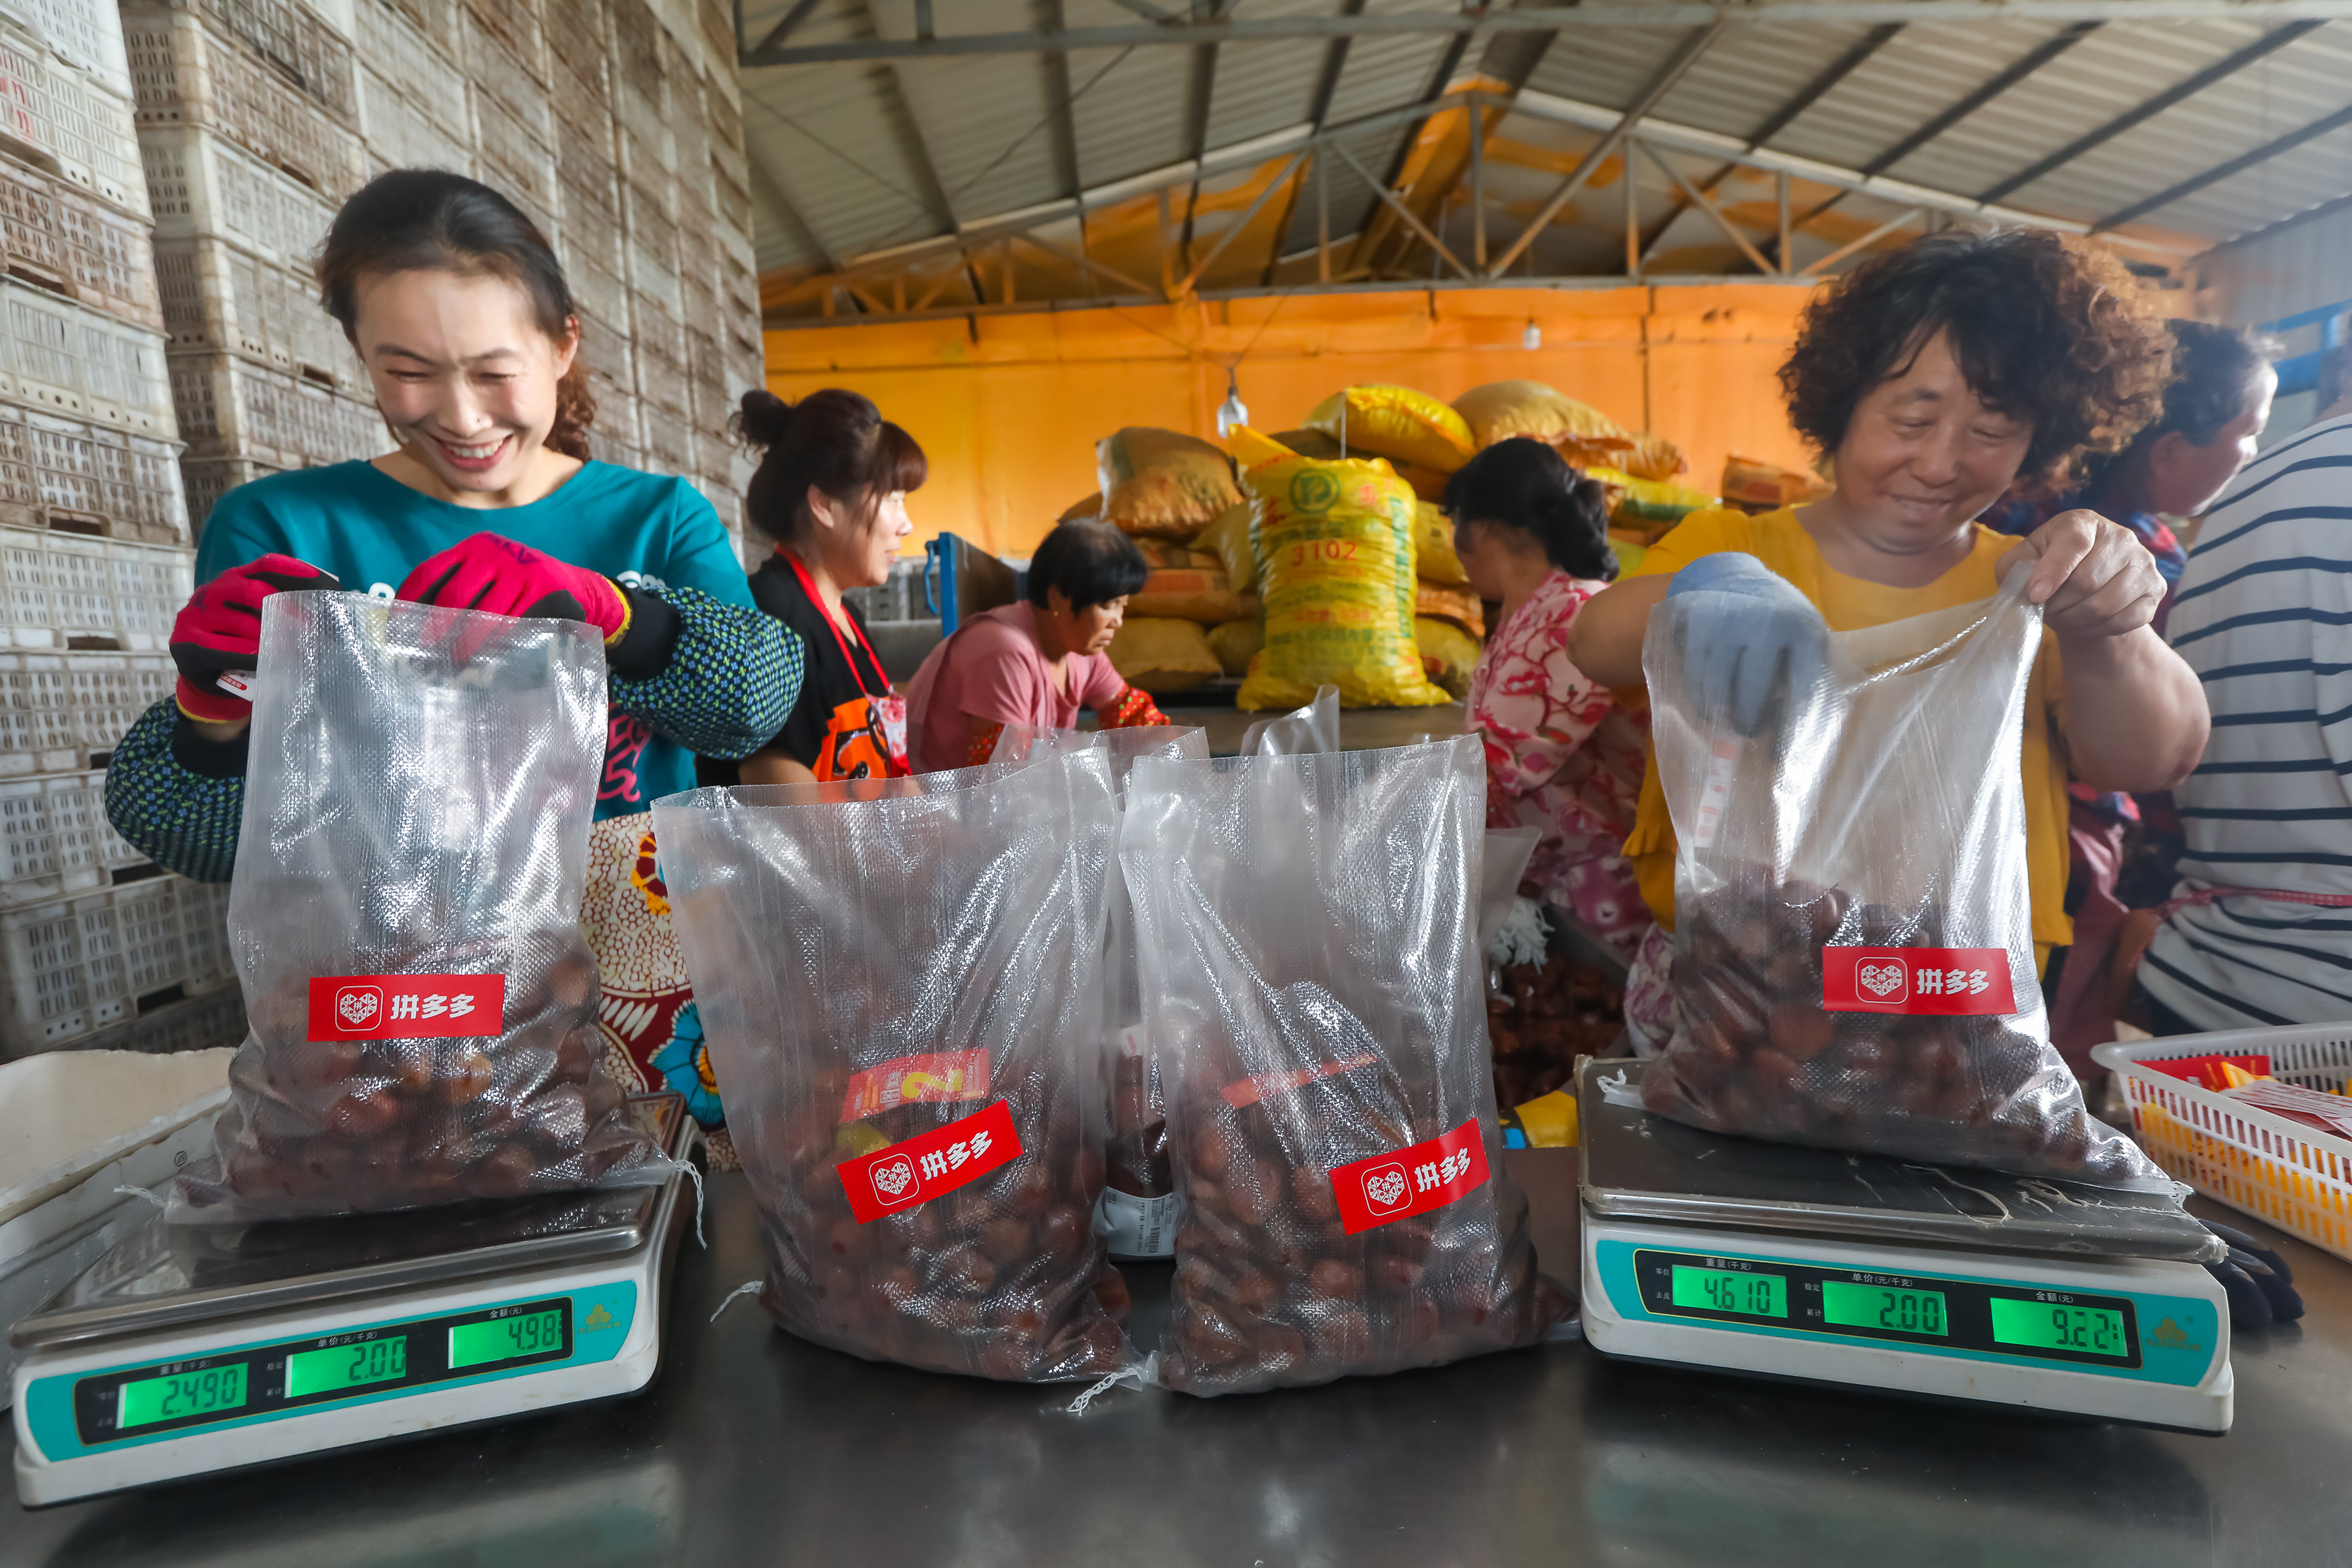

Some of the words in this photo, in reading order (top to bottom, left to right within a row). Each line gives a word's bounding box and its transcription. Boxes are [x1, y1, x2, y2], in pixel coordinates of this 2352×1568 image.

[1291, 540, 1357, 567] 3102
[1916, 968, 1990, 996] 拼多多
[390, 993, 475, 1020] 拼多多
[920, 1130, 993, 1181] 拼多多
[1414, 1147, 1472, 1193] 拼多多
[1705, 1258, 1752, 1271] 重量(千克)
[1804, 1283, 1820, 1292] 稳定
[1852, 1272, 1913, 1287] 单价(元/千克)
[1704, 1276, 1770, 1314] 4.610
[2035, 1291, 2074, 1304] 金额(元)
[489, 1306, 523, 1319] 金额(元)
[1806, 1308, 1822, 1317] 累计
[1879, 1292, 1940, 1333] 2.00
[509, 1313, 556, 1351] 4.98
[349, 1339, 406, 1381] 2.00
[162, 1369, 238, 1416] 2.490
